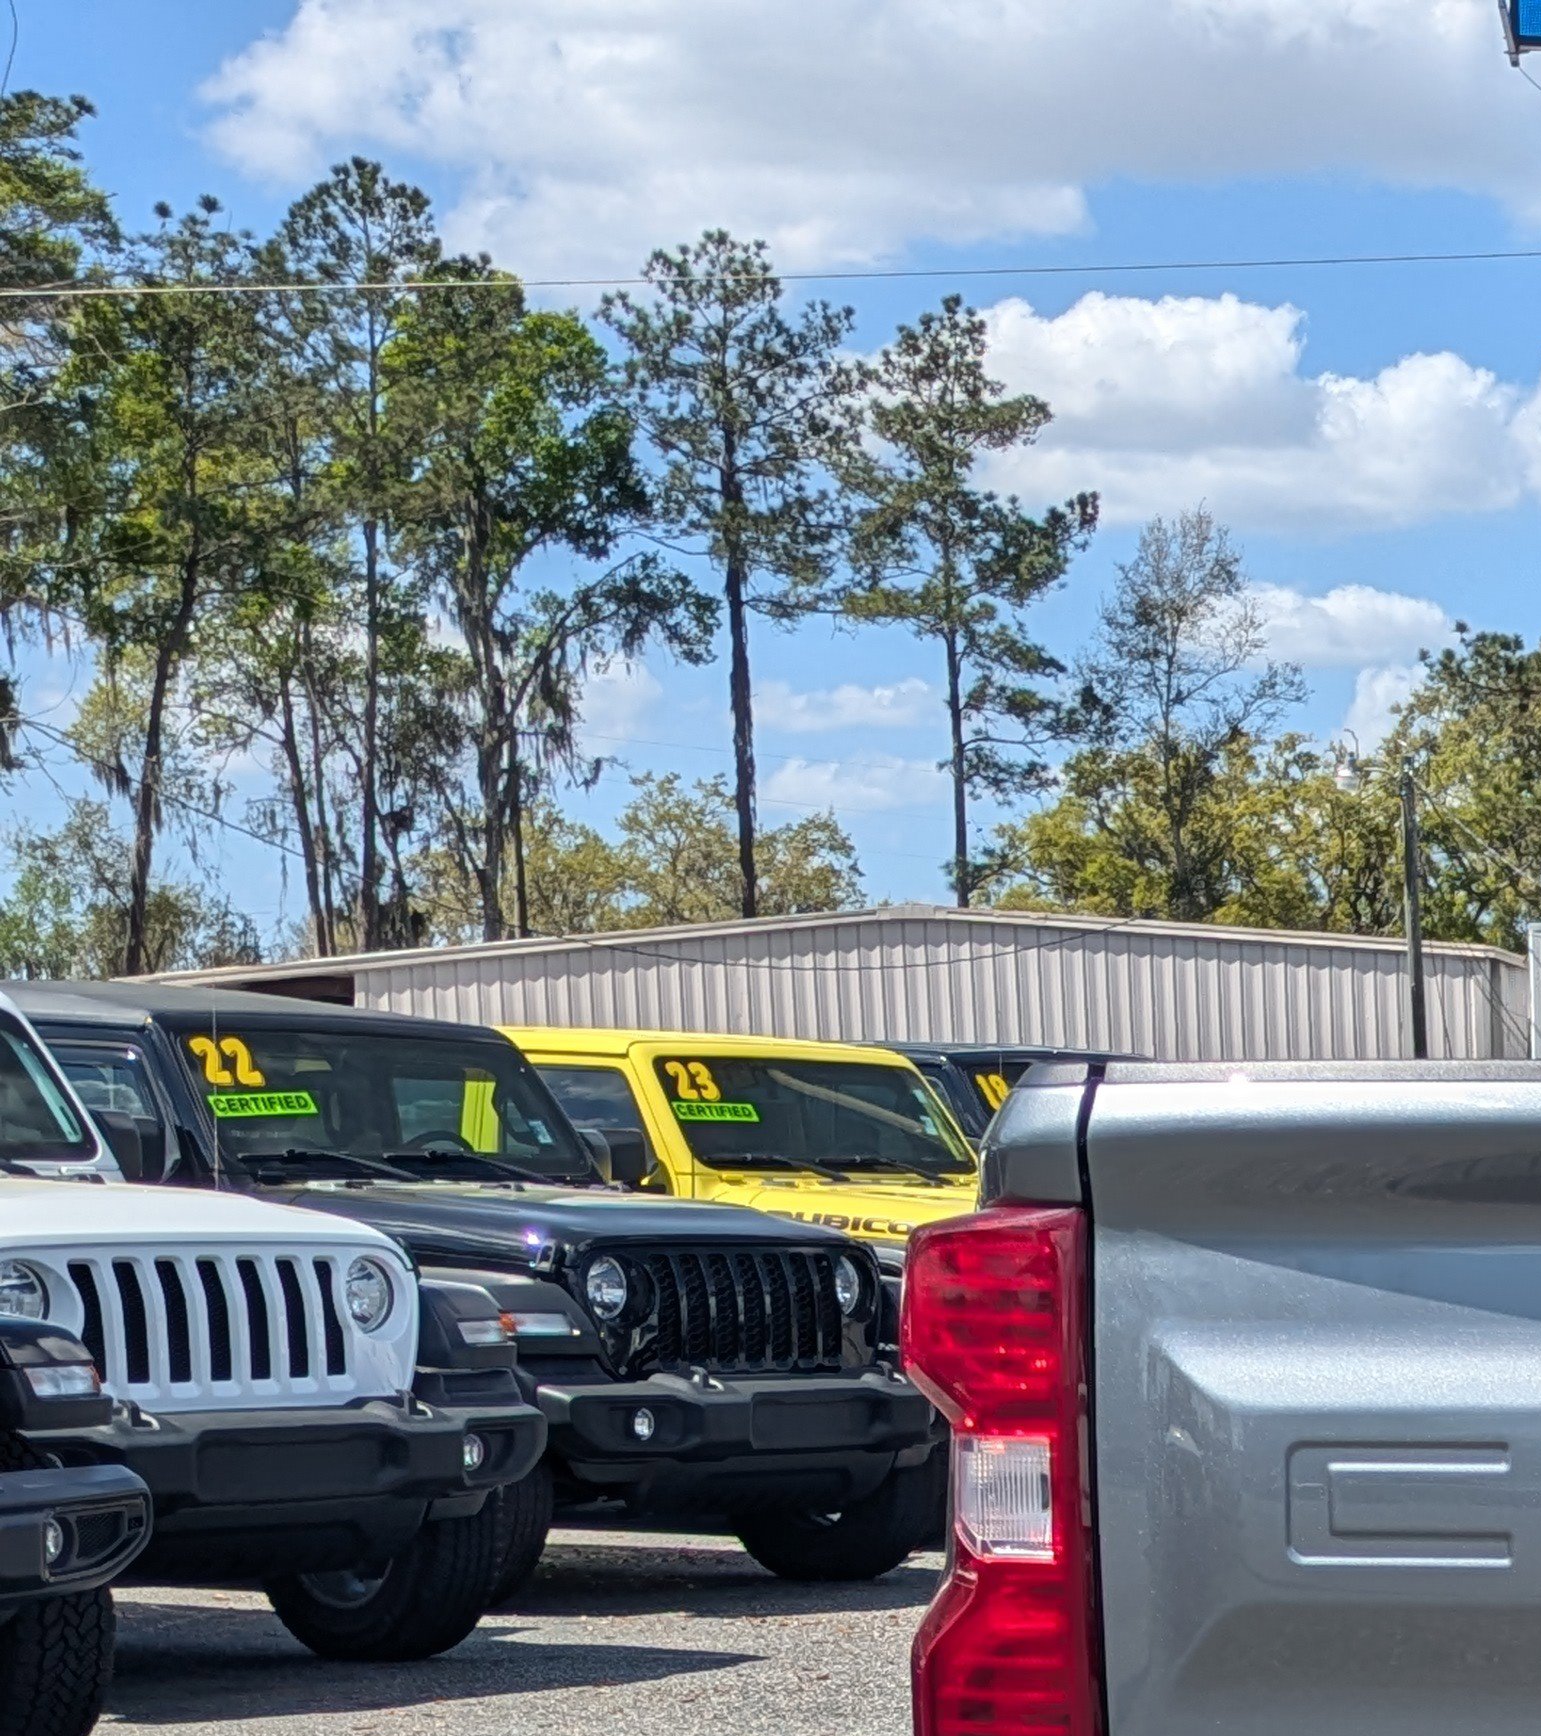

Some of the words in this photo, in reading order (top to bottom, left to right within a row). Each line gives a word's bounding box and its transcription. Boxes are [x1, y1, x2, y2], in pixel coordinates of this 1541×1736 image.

[189, 1037, 266, 1087] 22
[665, 1061, 720, 1101] 23
[213, 1094, 310, 1114] CERTIFIED
[675, 1104, 752, 1118] CERTIFIED
[767, 1210, 914, 1235] UBICO
